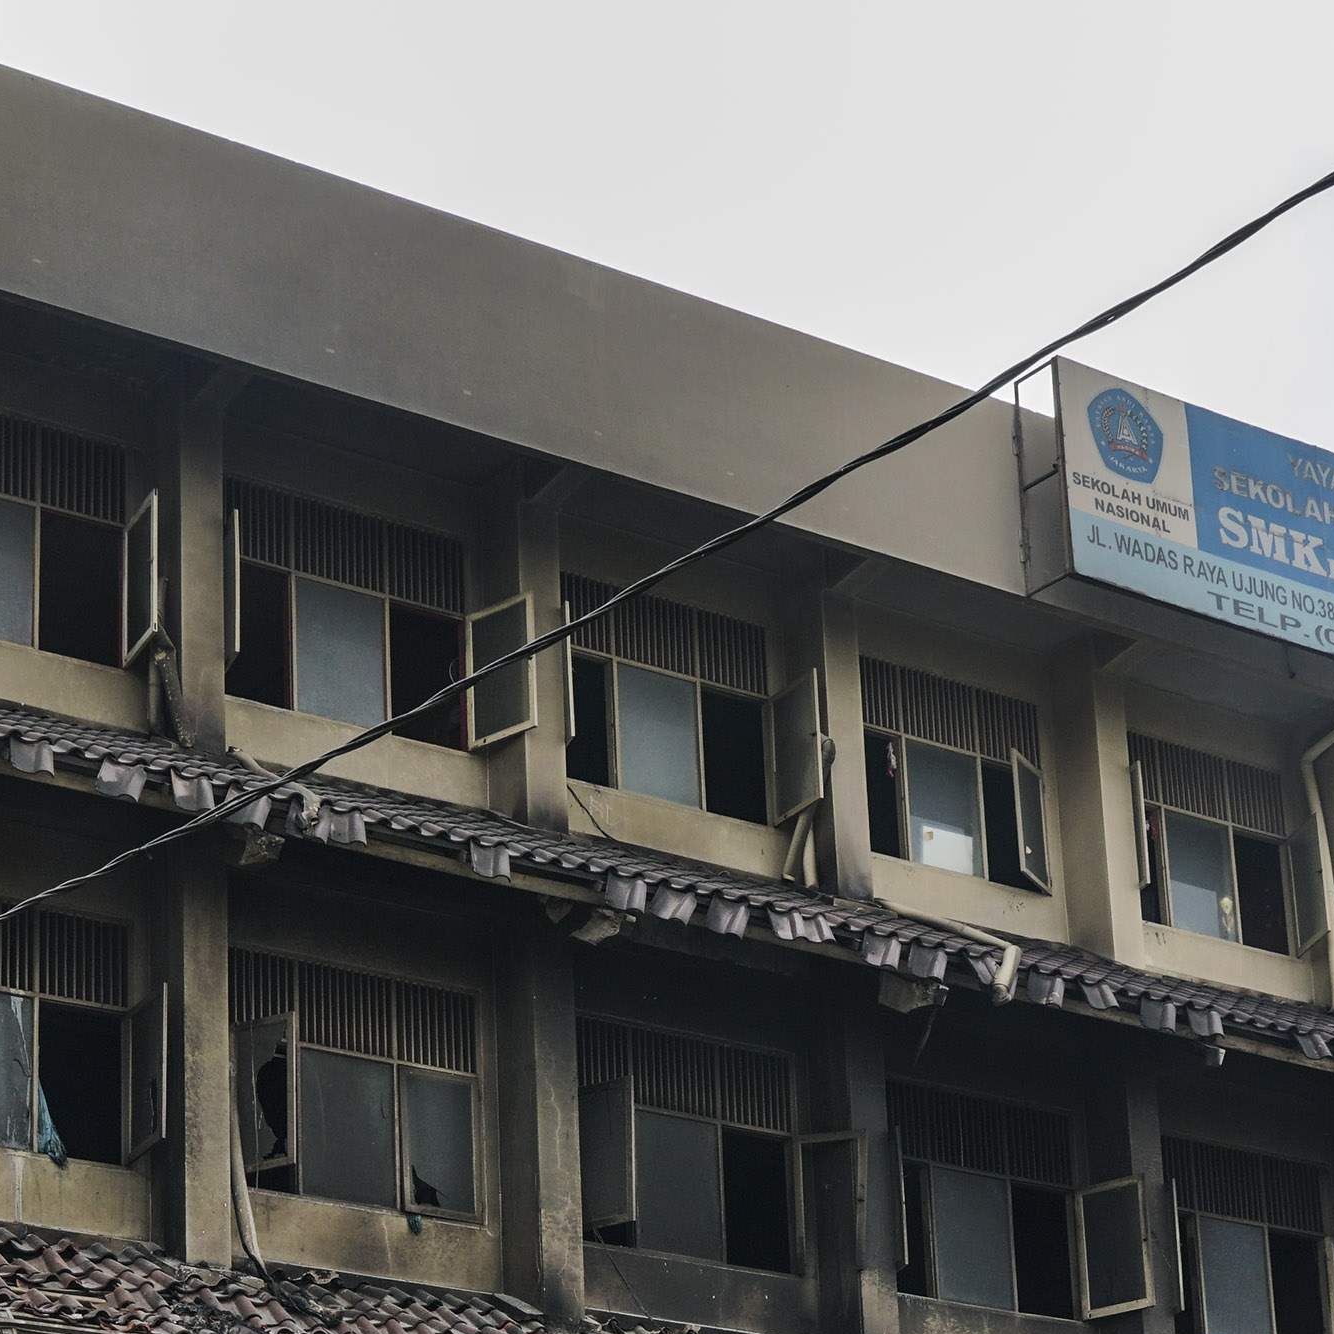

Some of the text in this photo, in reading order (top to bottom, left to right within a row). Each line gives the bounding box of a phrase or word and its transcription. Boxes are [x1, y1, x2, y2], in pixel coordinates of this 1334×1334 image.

[1072, 471, 1190, 522] SEKOLAH UMUM
[1094, 497, 1171, 534] NASIONAL
[1218, 506, 1327, 577] SMK
[1087, 524, 1112, 550] JL.
[1115, 532, 1178, 570] WADAS
[1183, 555, 1228, 588] RAYA
[1232, 571, 1287, 606] UJUNG
[1291, 590, 1334, 621] NO.38
